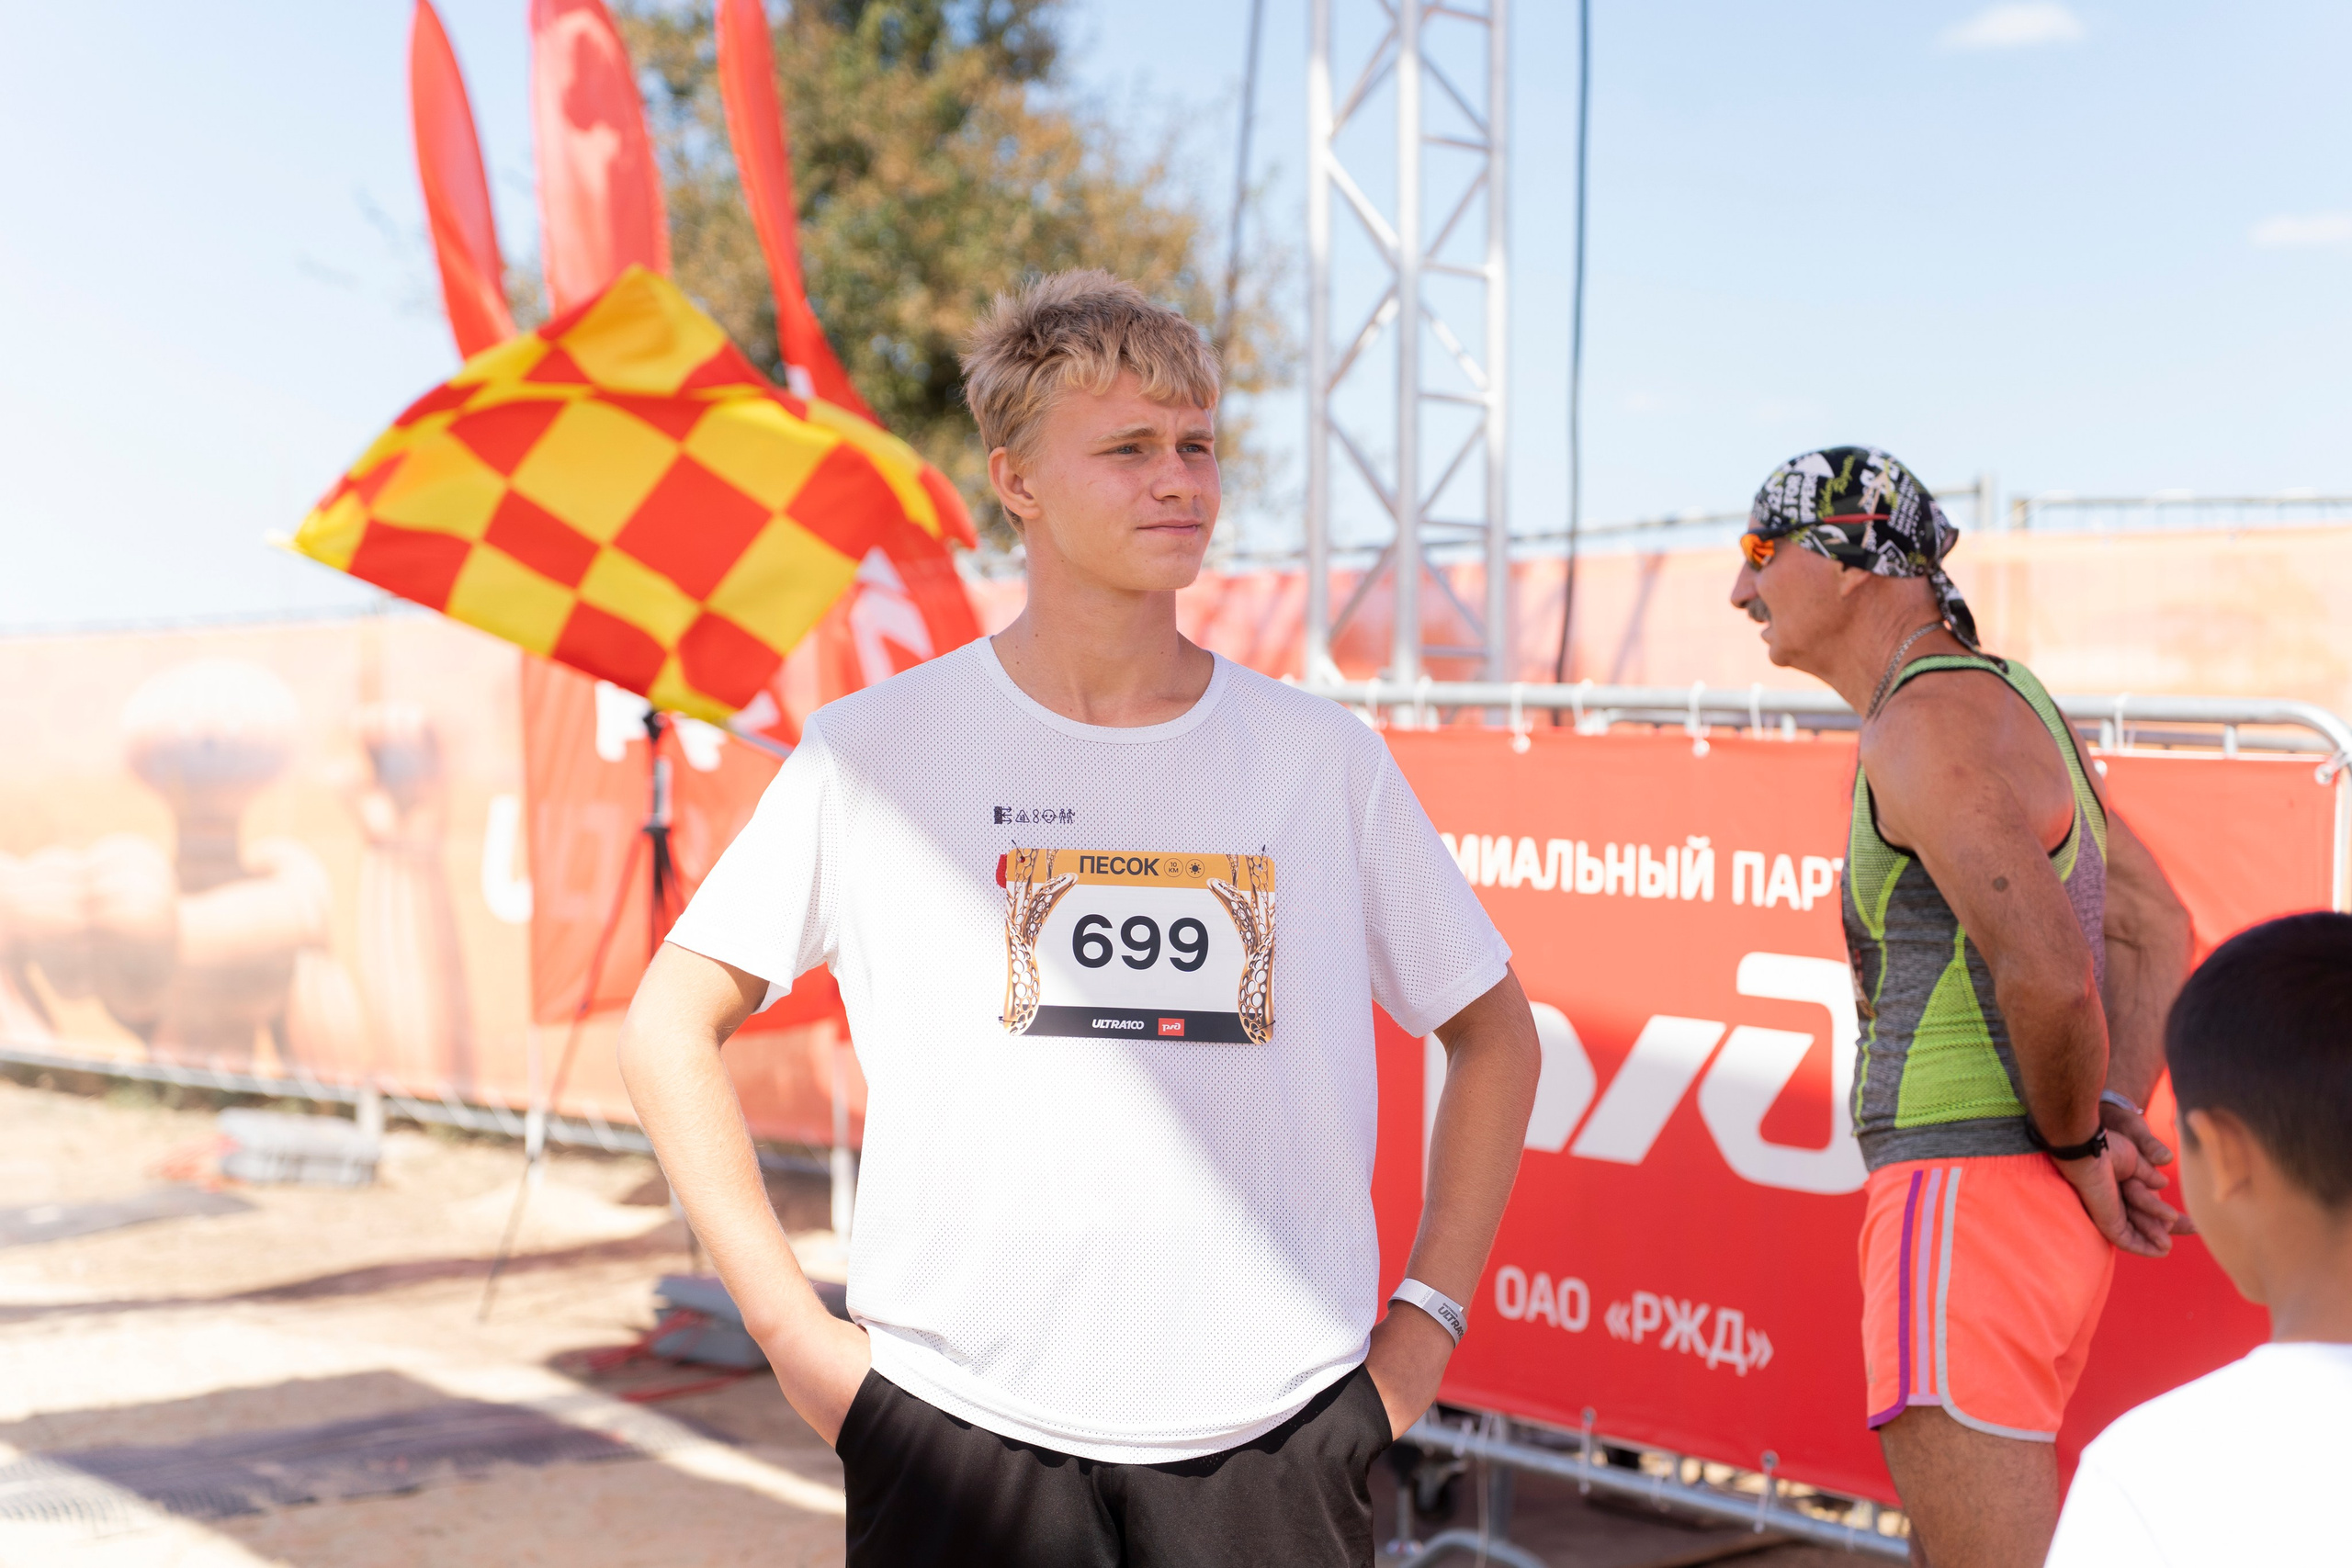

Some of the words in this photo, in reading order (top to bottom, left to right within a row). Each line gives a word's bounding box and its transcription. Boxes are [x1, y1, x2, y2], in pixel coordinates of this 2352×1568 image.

[1080, 855, 1159, 876] ПЕСОК
[1072, 913, 1209, 972] 699
[1091, 1019, 1145, 1030] ULTRA100
[1494, 1264, 1591, 1333] ОАО
[1604, 1289, 1774, 1377] «РЖД»
